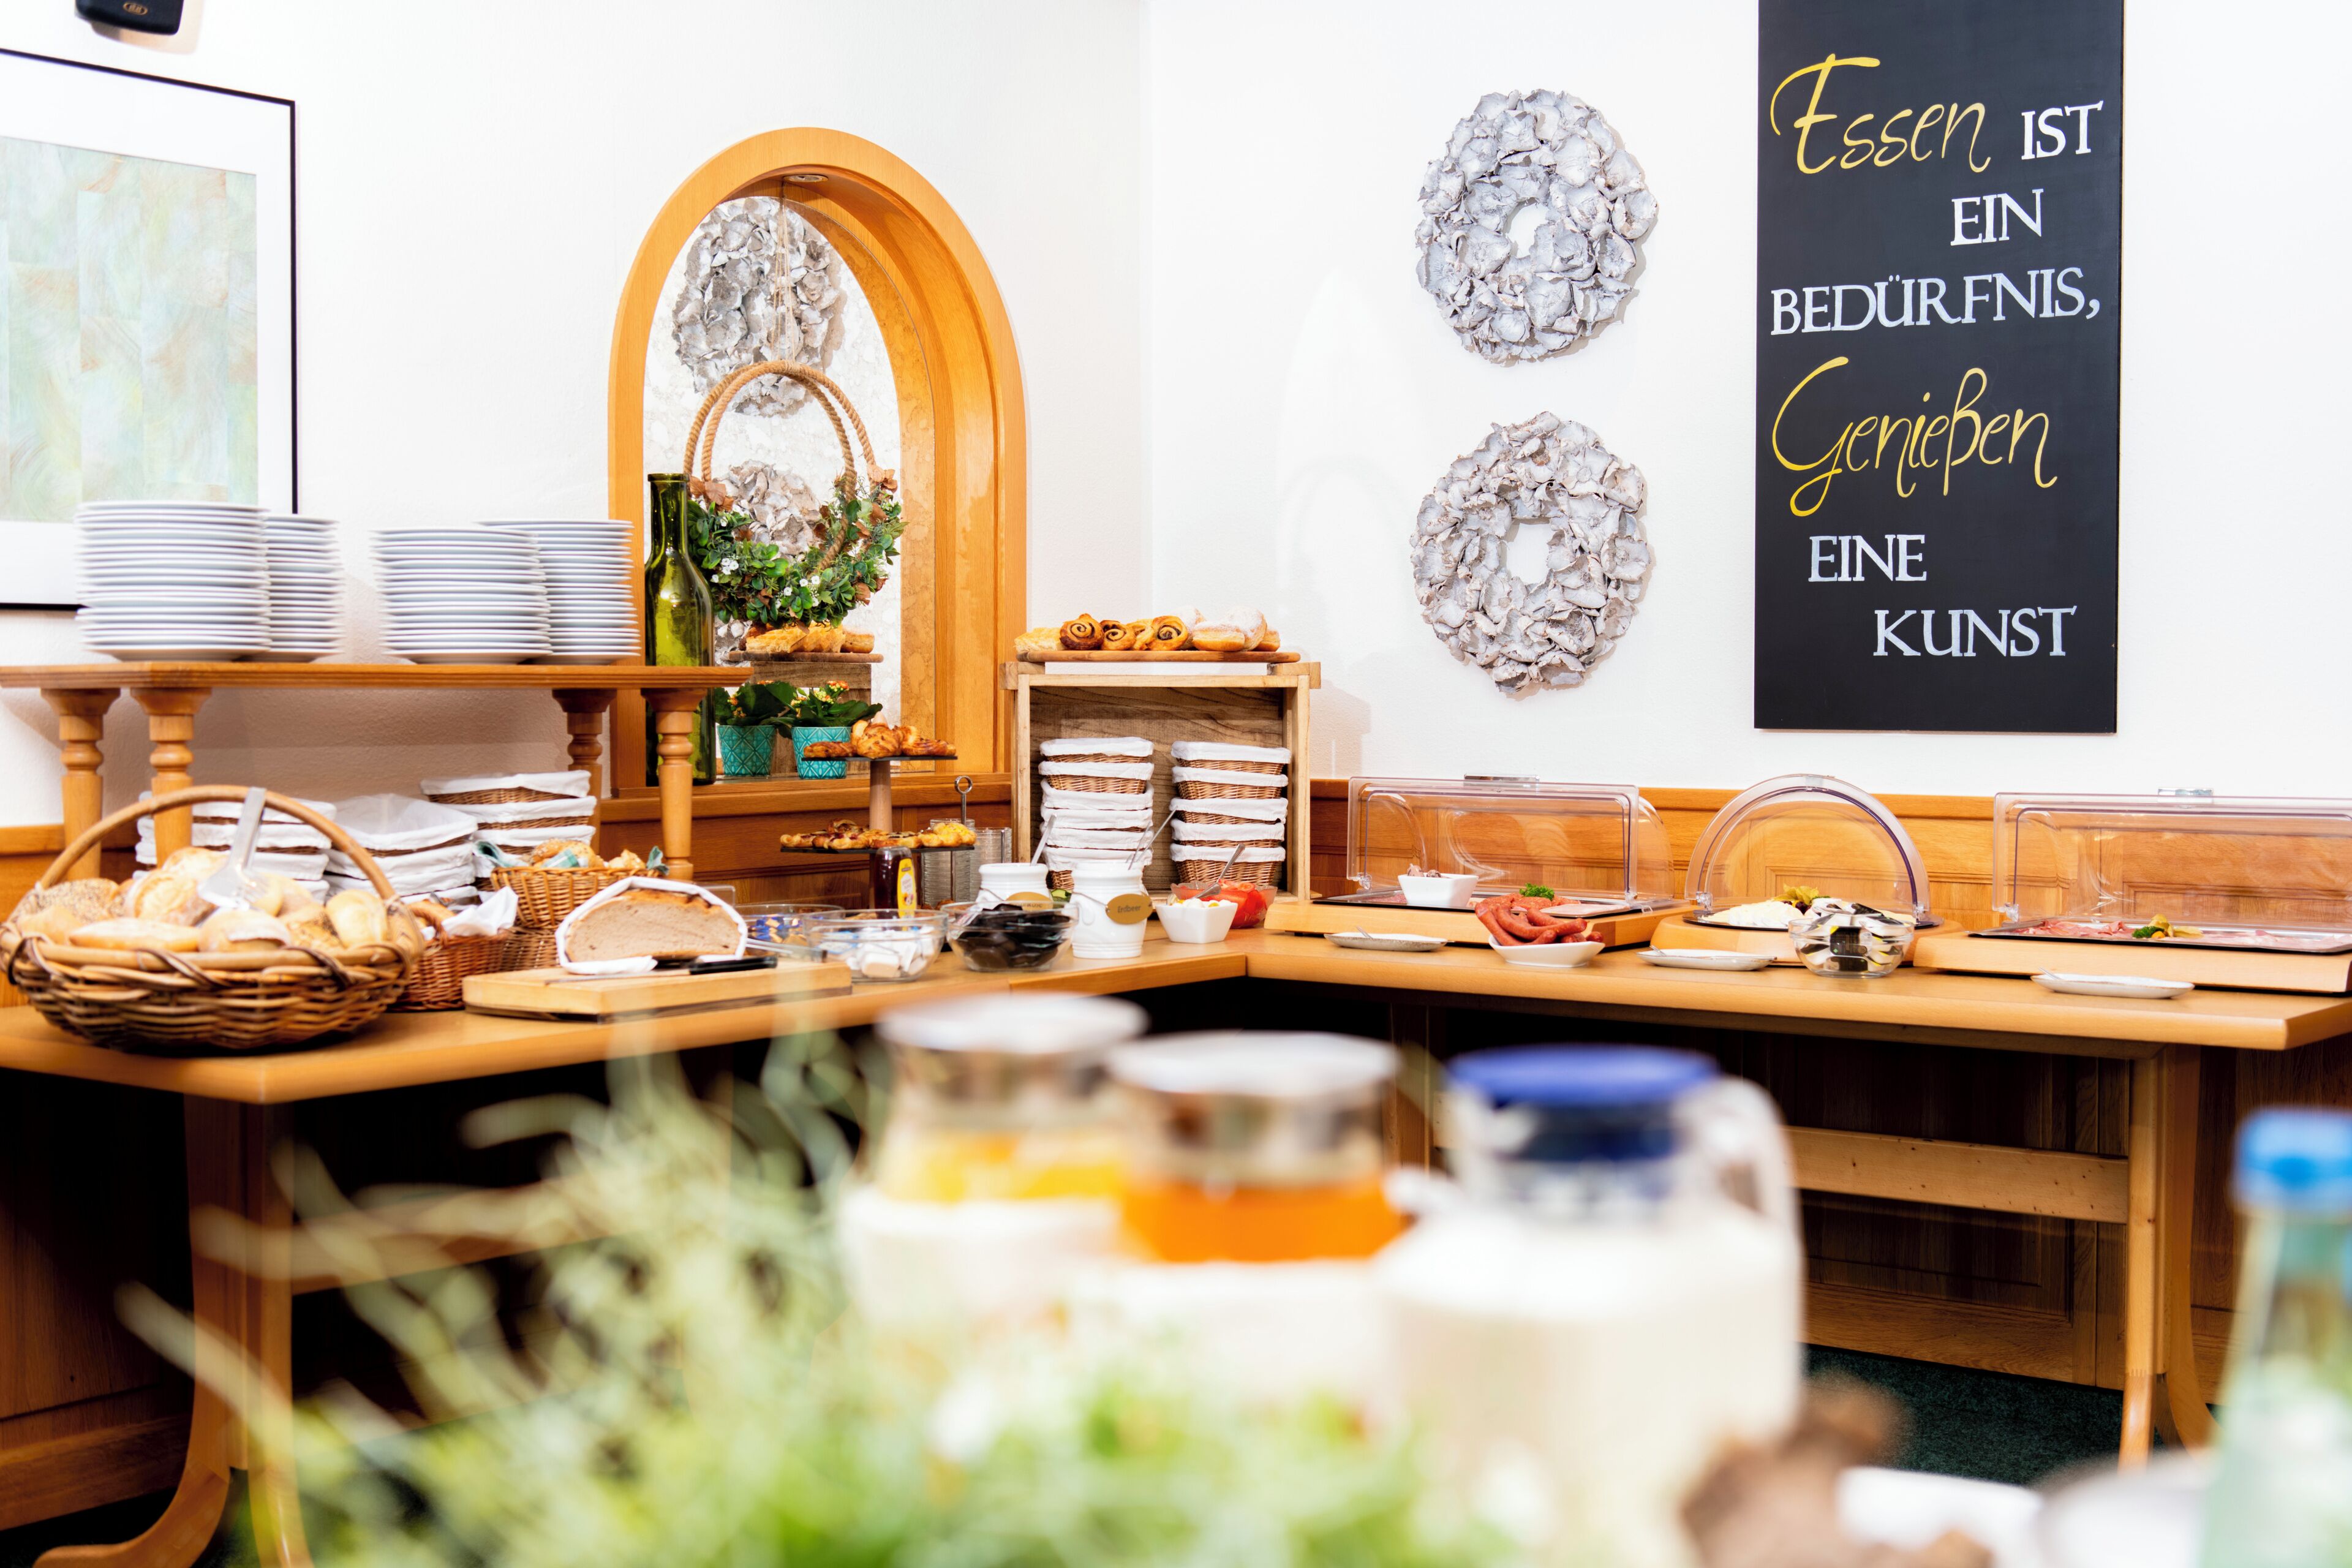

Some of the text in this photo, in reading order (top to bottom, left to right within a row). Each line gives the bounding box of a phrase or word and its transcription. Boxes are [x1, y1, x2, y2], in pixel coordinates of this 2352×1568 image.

[1770, 53, 2103, 174] Essen IST
[1950, 189, 2043, 246] EIN
[1771, 268, 2100, 335] BEDÜRFNIS,
[1773, 356, 2057, 516] Genießen
[1809, 535, 1926, 582] EINE
[1874, 606, 2076, 657] KUNST
